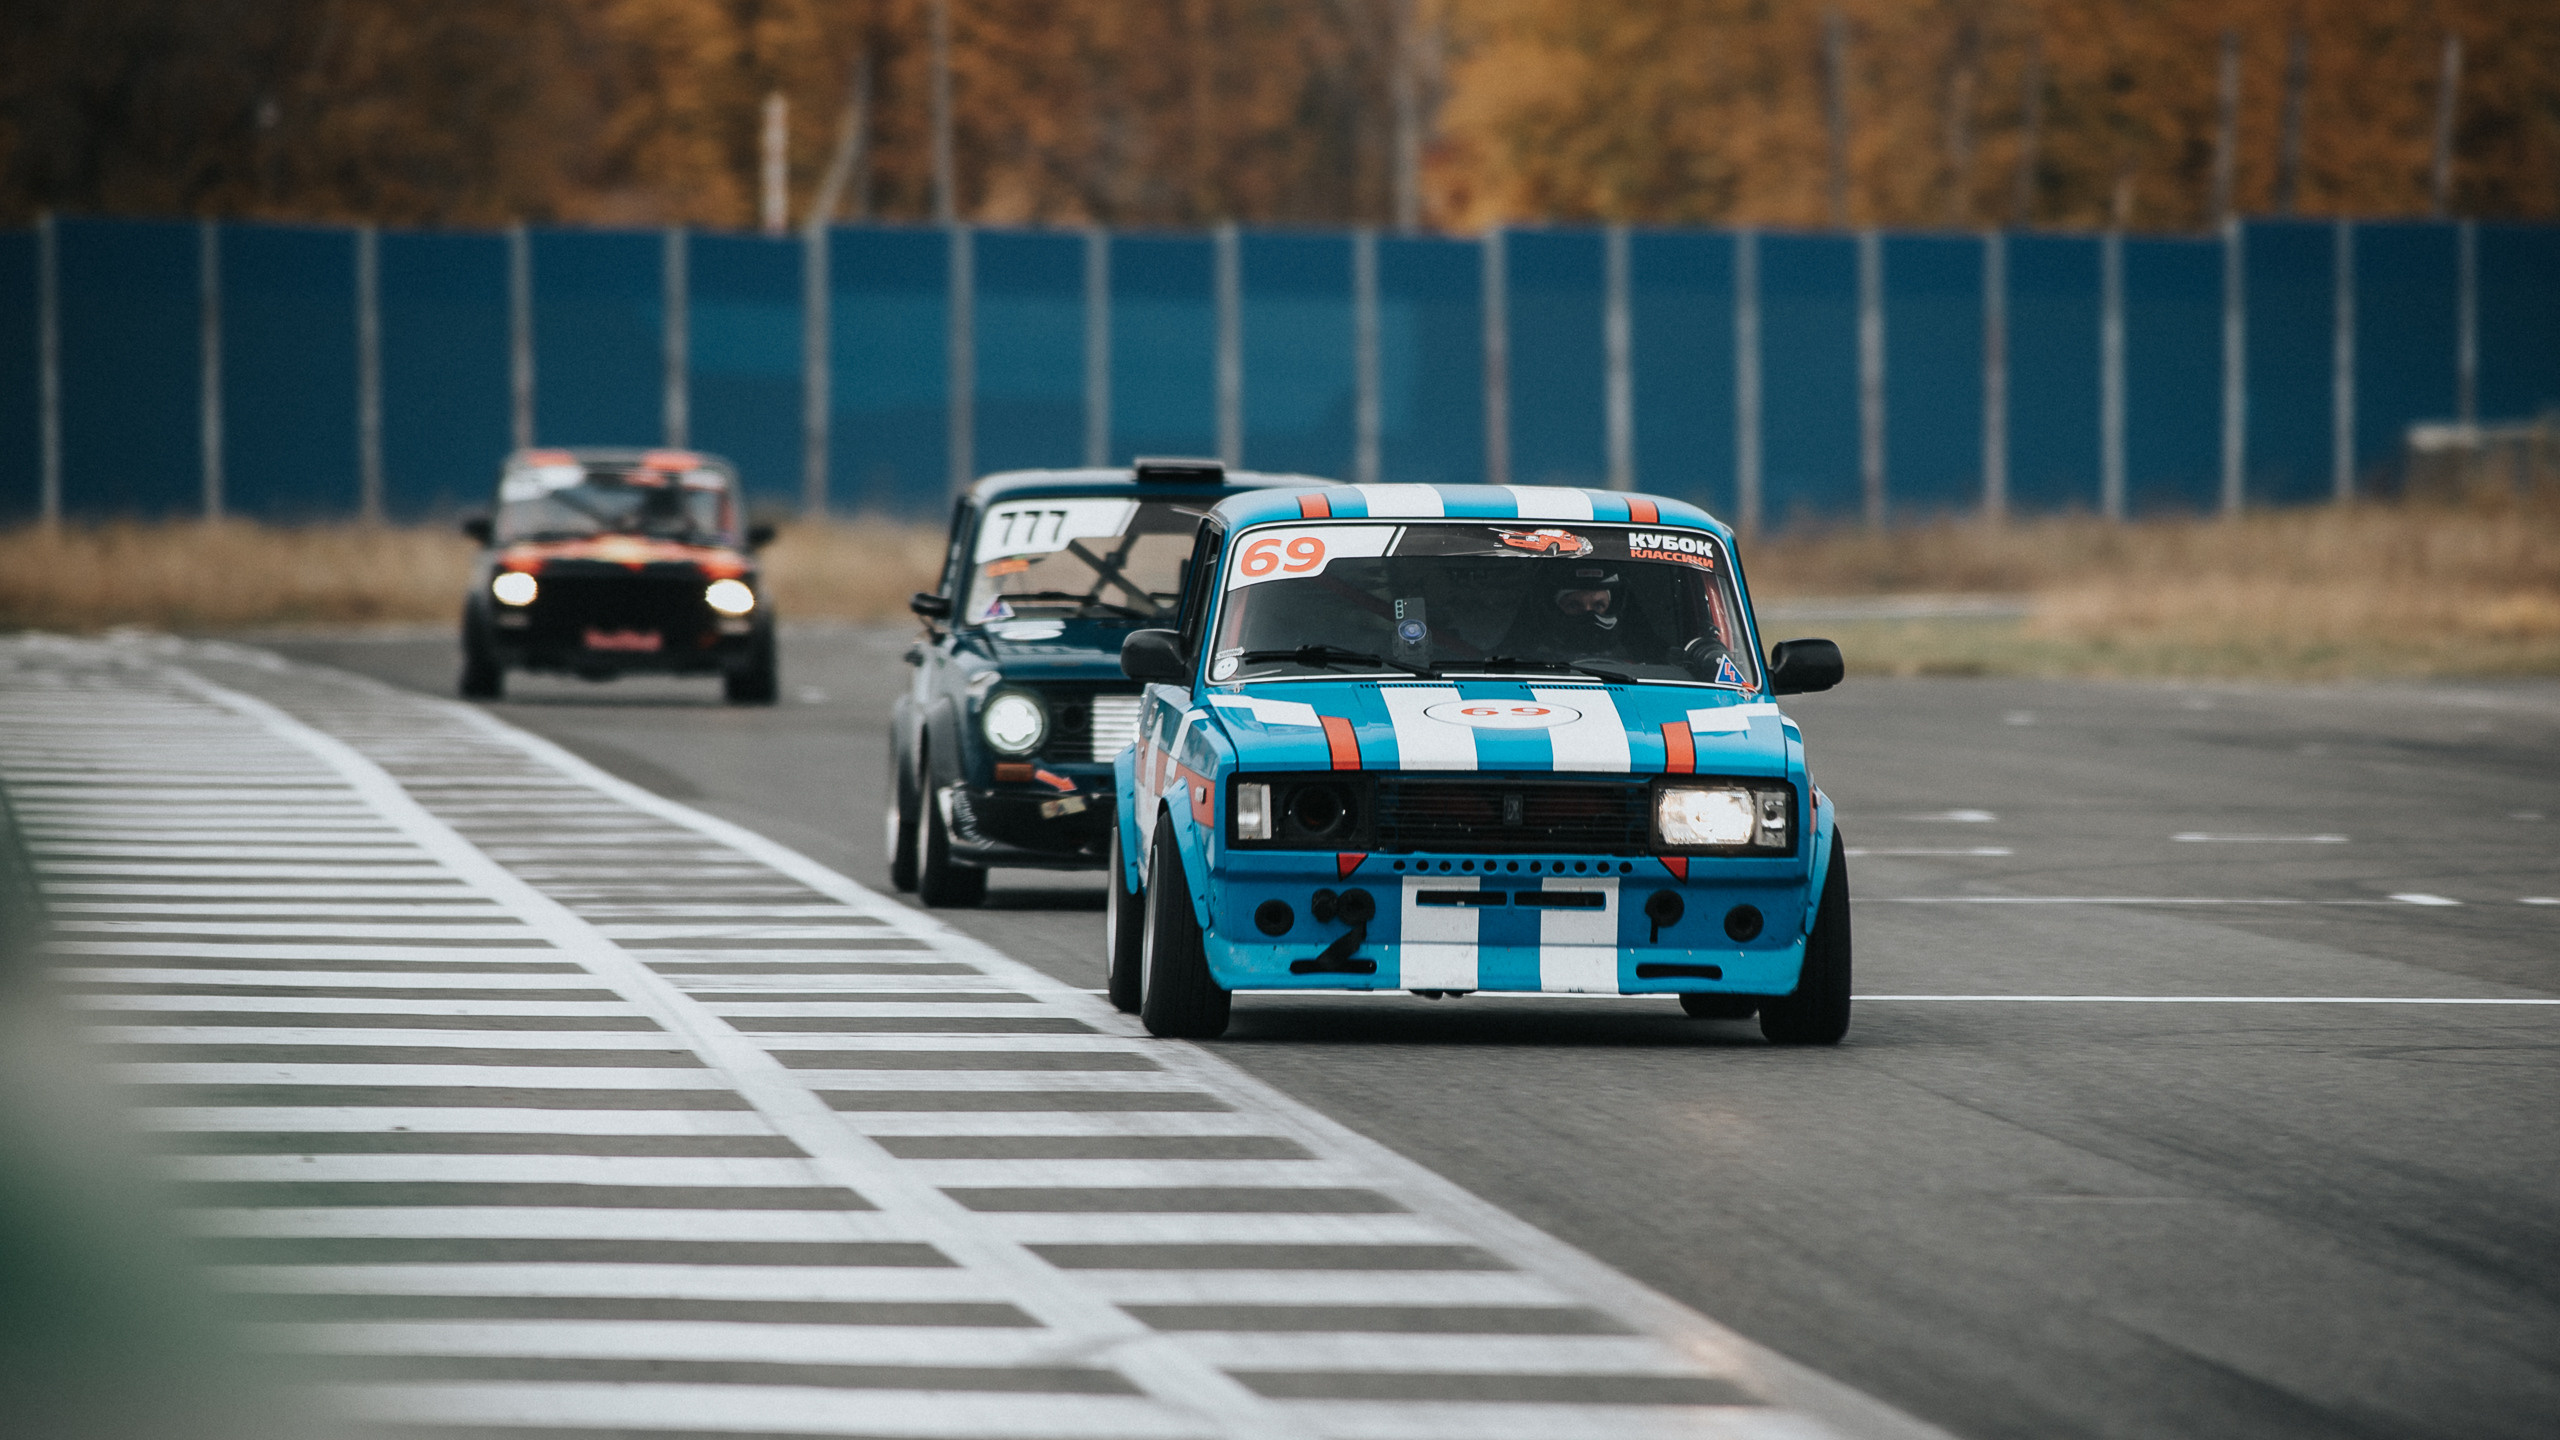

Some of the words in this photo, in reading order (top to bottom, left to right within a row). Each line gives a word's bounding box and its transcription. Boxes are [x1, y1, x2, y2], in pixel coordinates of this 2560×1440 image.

[1000, 510, 1067, 546] 777
[1240, 536, 1326, 577] 69
[1628, 532, 1714, 558] КУБОК
[1630, 549, 1714, 569] КЛАССИКИ
